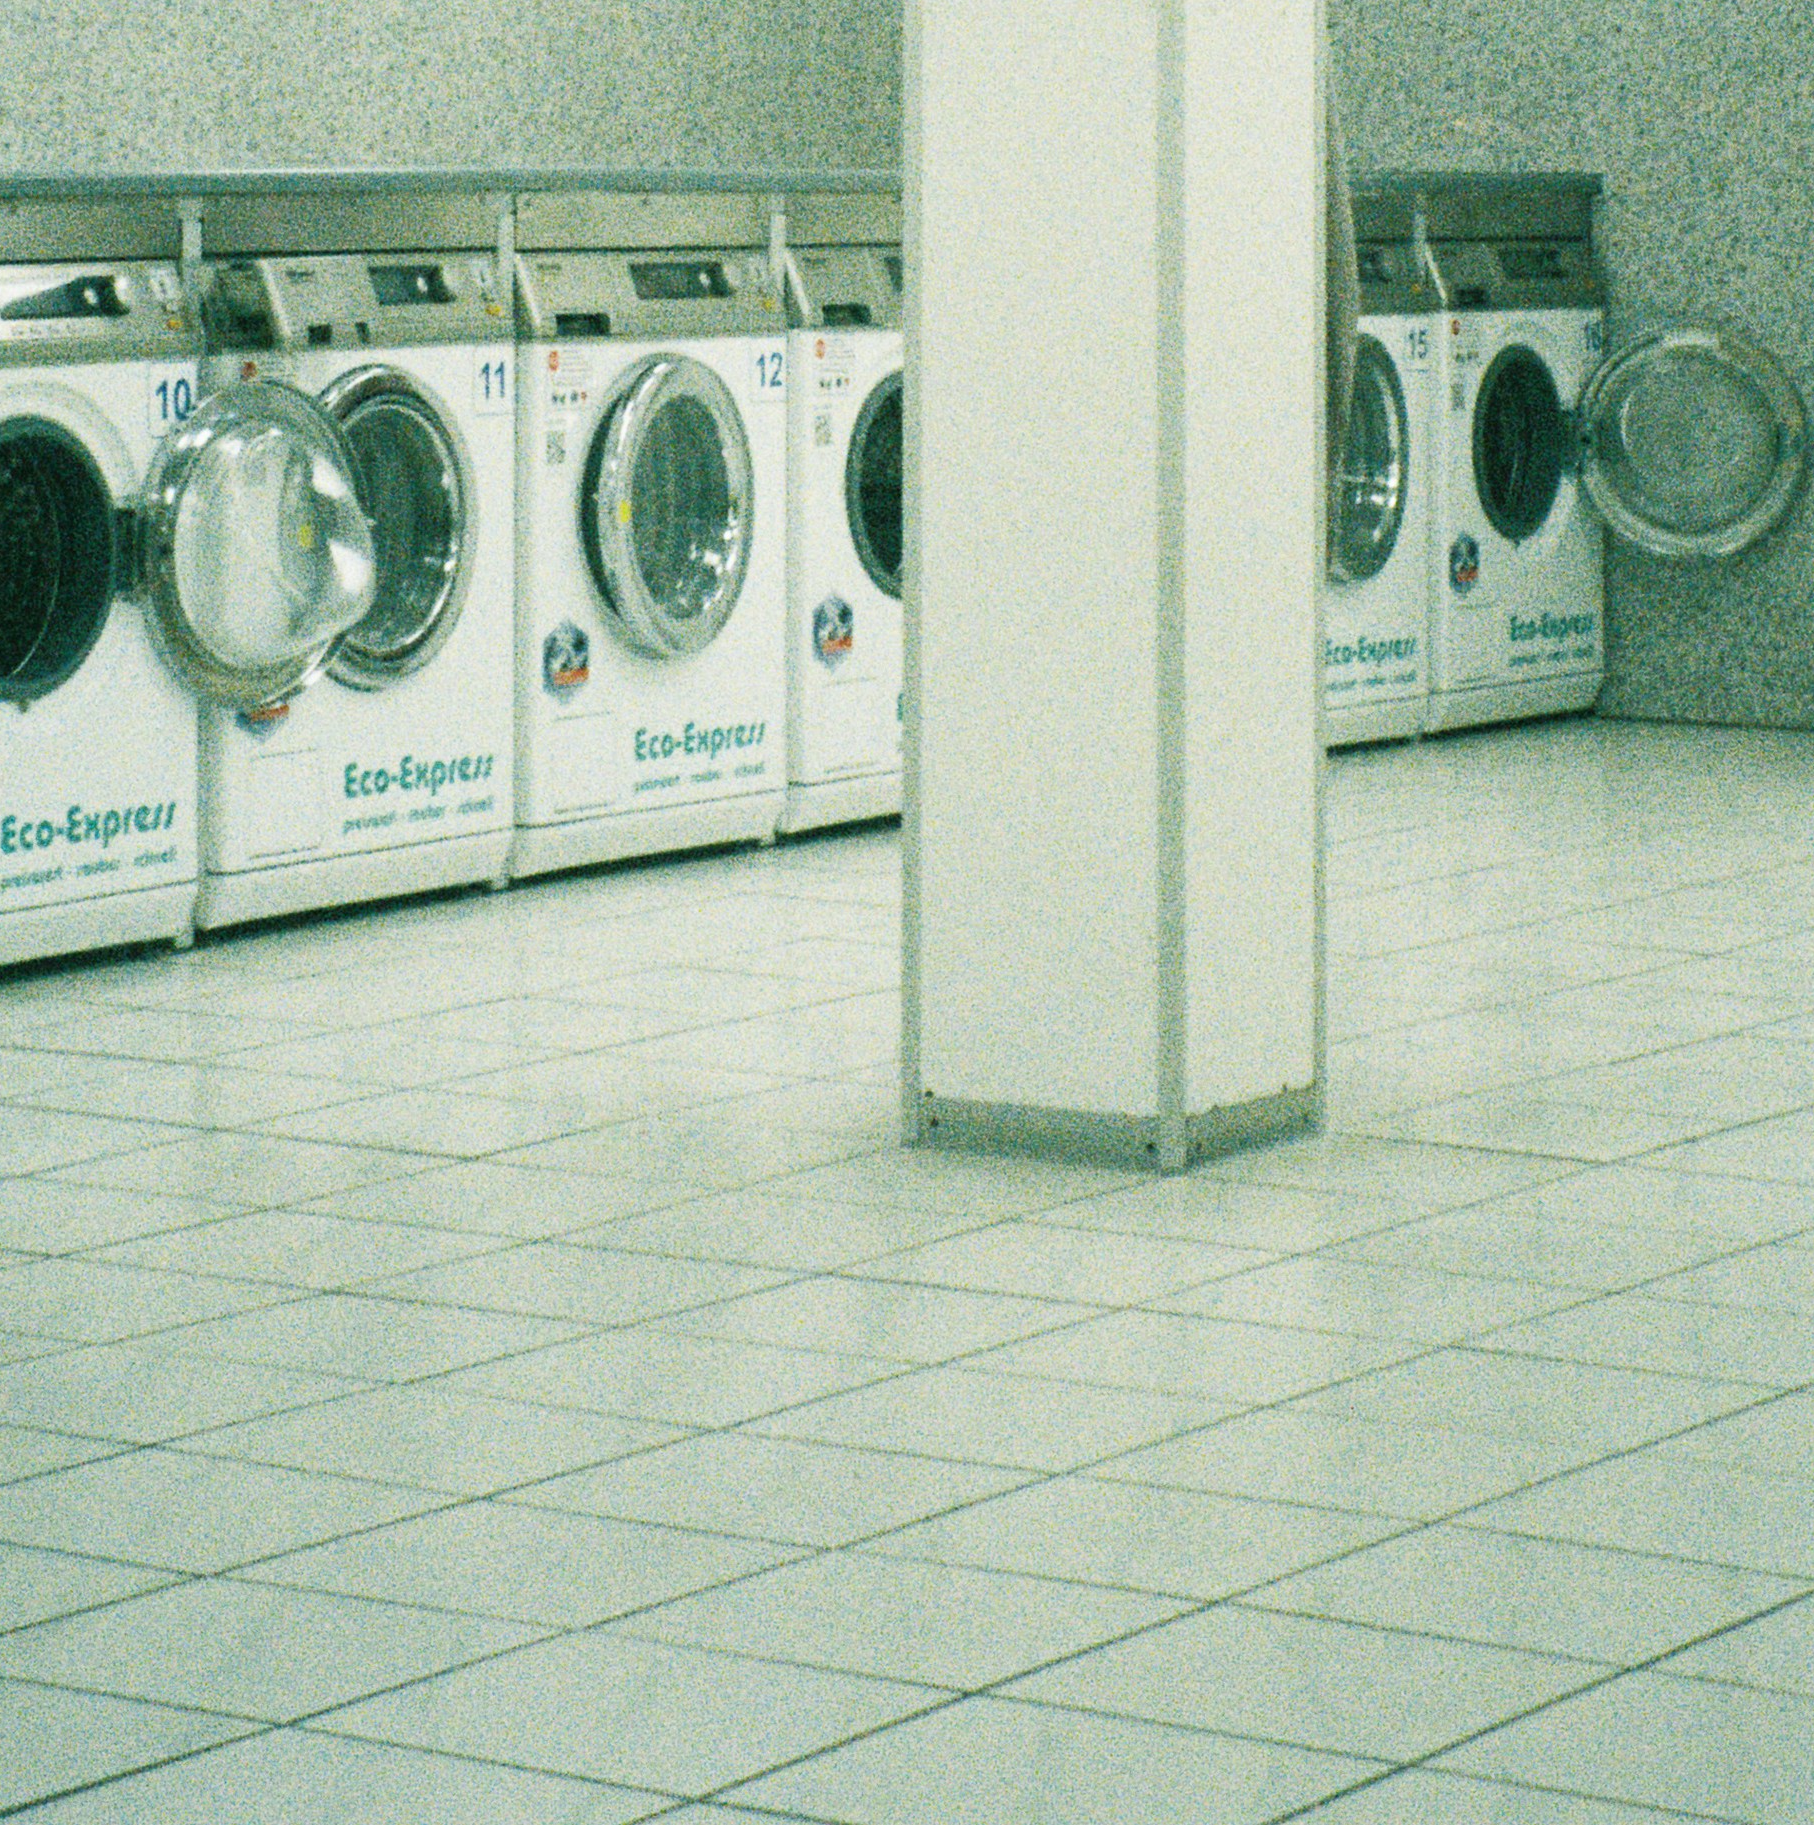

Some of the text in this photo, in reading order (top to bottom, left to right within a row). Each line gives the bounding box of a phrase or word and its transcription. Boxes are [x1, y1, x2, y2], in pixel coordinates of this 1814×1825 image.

[1408, 327, 1429, 360] 15
[479, 363, 507, 401] 11
[755, 352, 784, 388] 12
[155, 377, 191, 422] 10
[634, 720, 767, 762] Eco-Express
[343, 753, 494, 798] Eco-Express
[0, 800, 177, 854] Eco-Express
